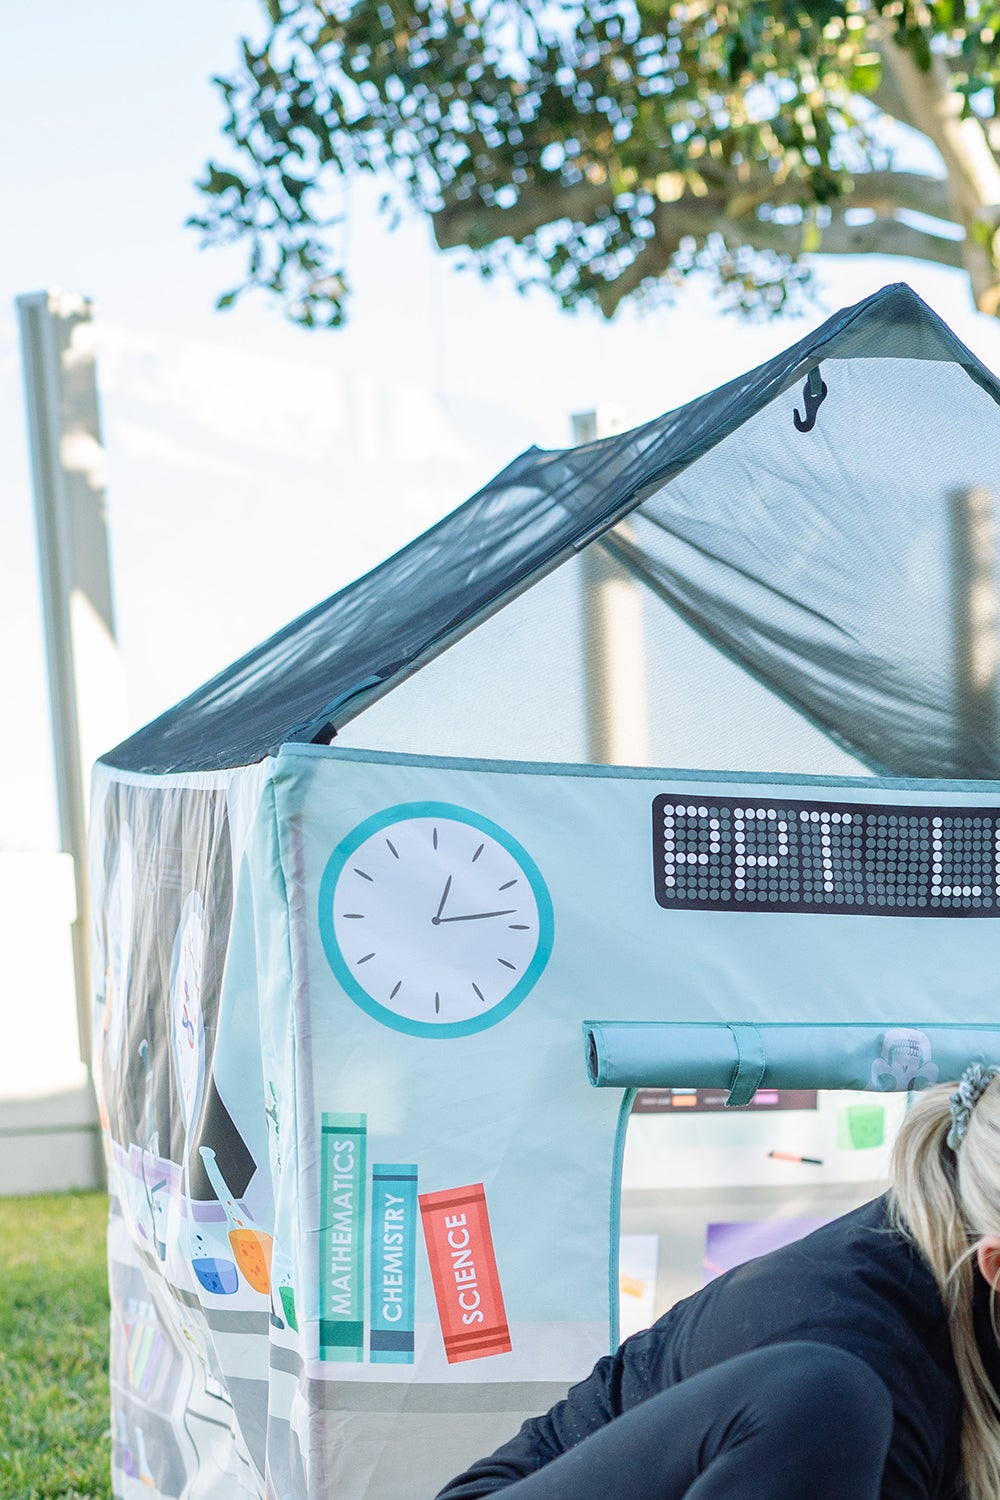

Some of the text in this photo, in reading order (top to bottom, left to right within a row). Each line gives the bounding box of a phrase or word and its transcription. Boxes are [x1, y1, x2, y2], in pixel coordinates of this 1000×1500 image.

[663, 804, 852, 892] PPT
[332, 1140, 355, 1315] MATHEMATICS
[383, 1193, 405, 1323] CHEMISTRY
[445, 1213, 484, 1325] SCIENCE
